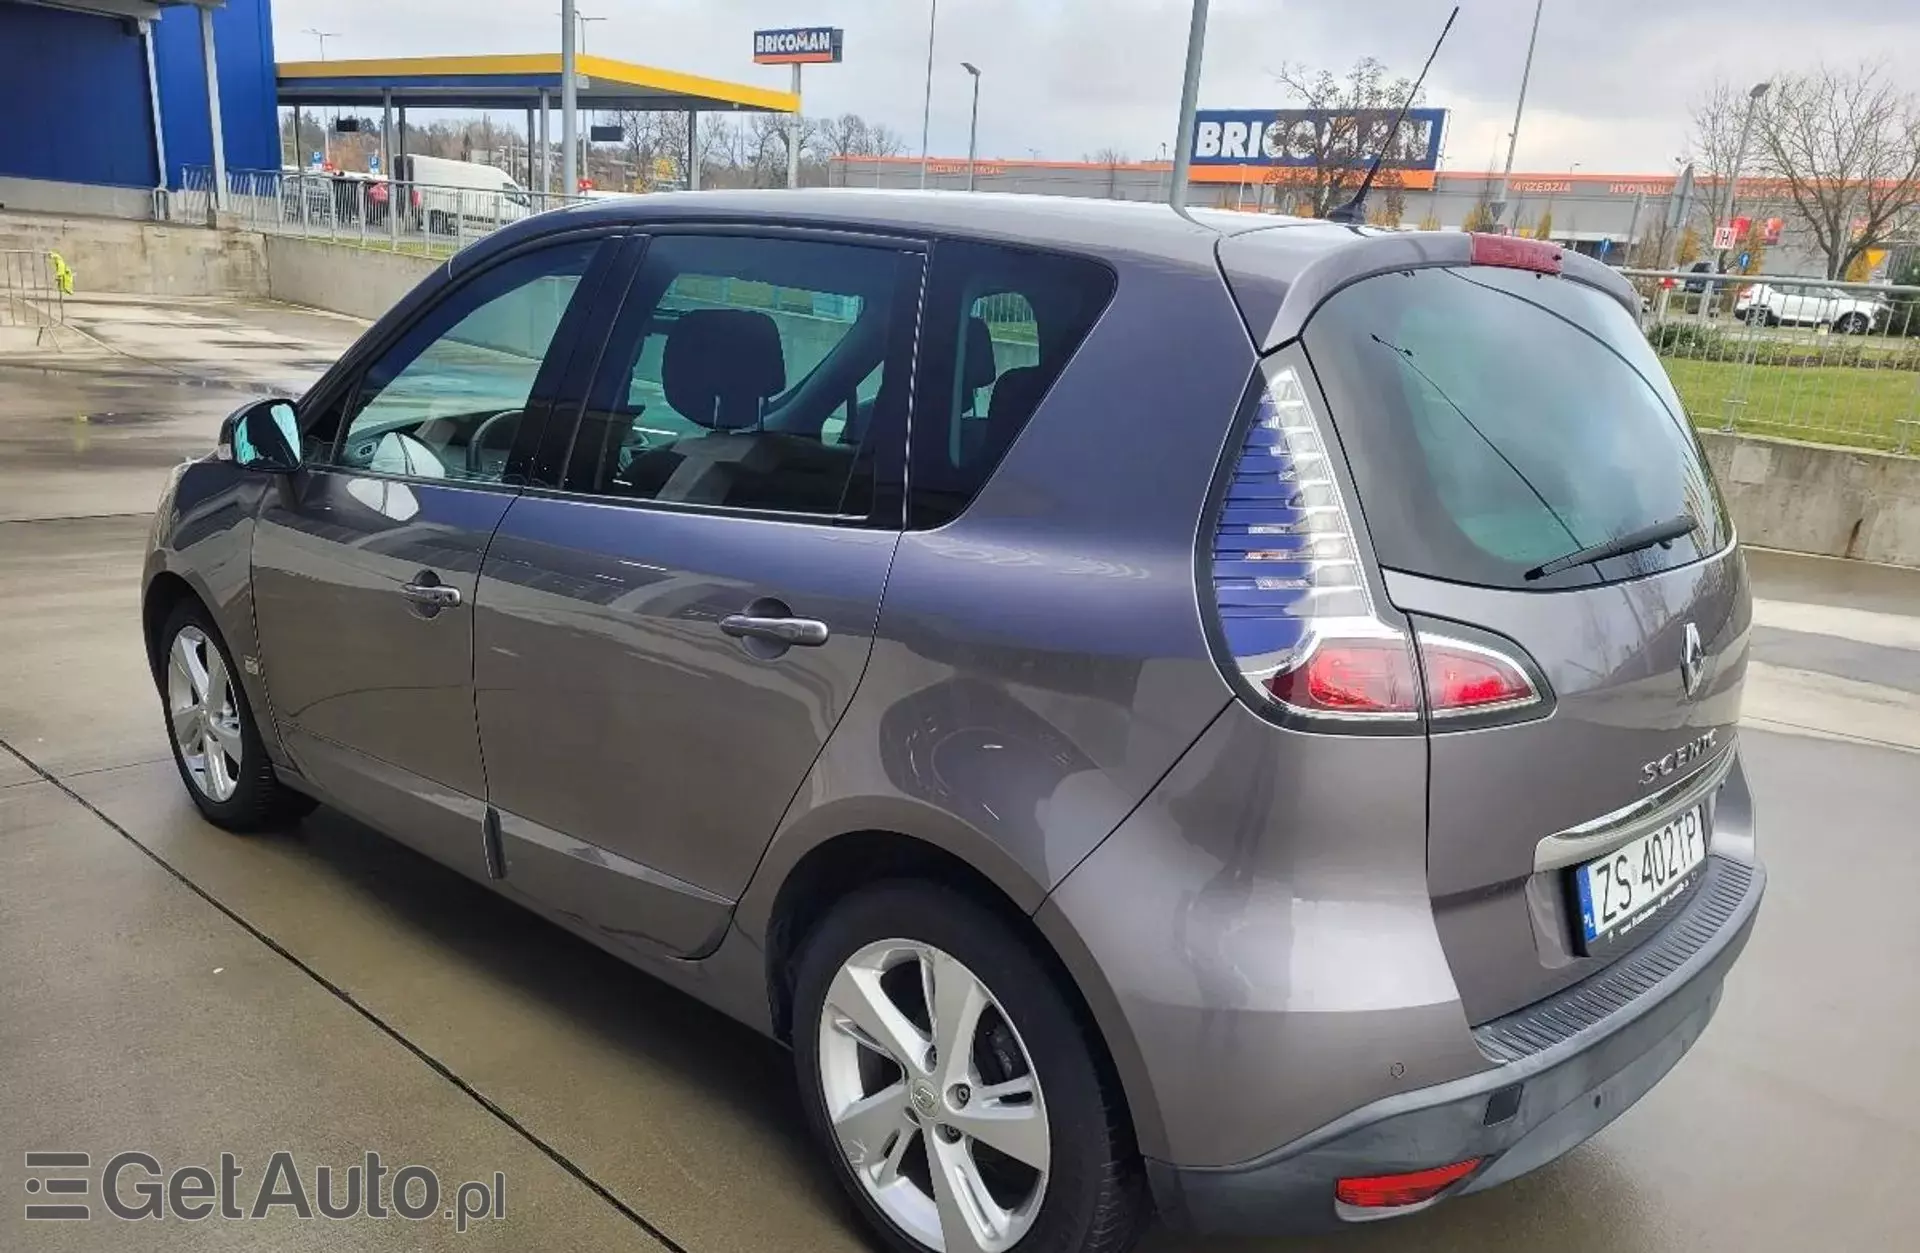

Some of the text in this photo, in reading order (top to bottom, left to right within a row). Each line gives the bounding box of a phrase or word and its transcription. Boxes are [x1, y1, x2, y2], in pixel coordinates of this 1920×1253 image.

[755, 32, 829, 52] BRICOMAN
[1638, 728, 1717, 784] SCENIC
[1597, 854, 1632, 923] ZS
[1641, 811, 1696, 892] 402TP
